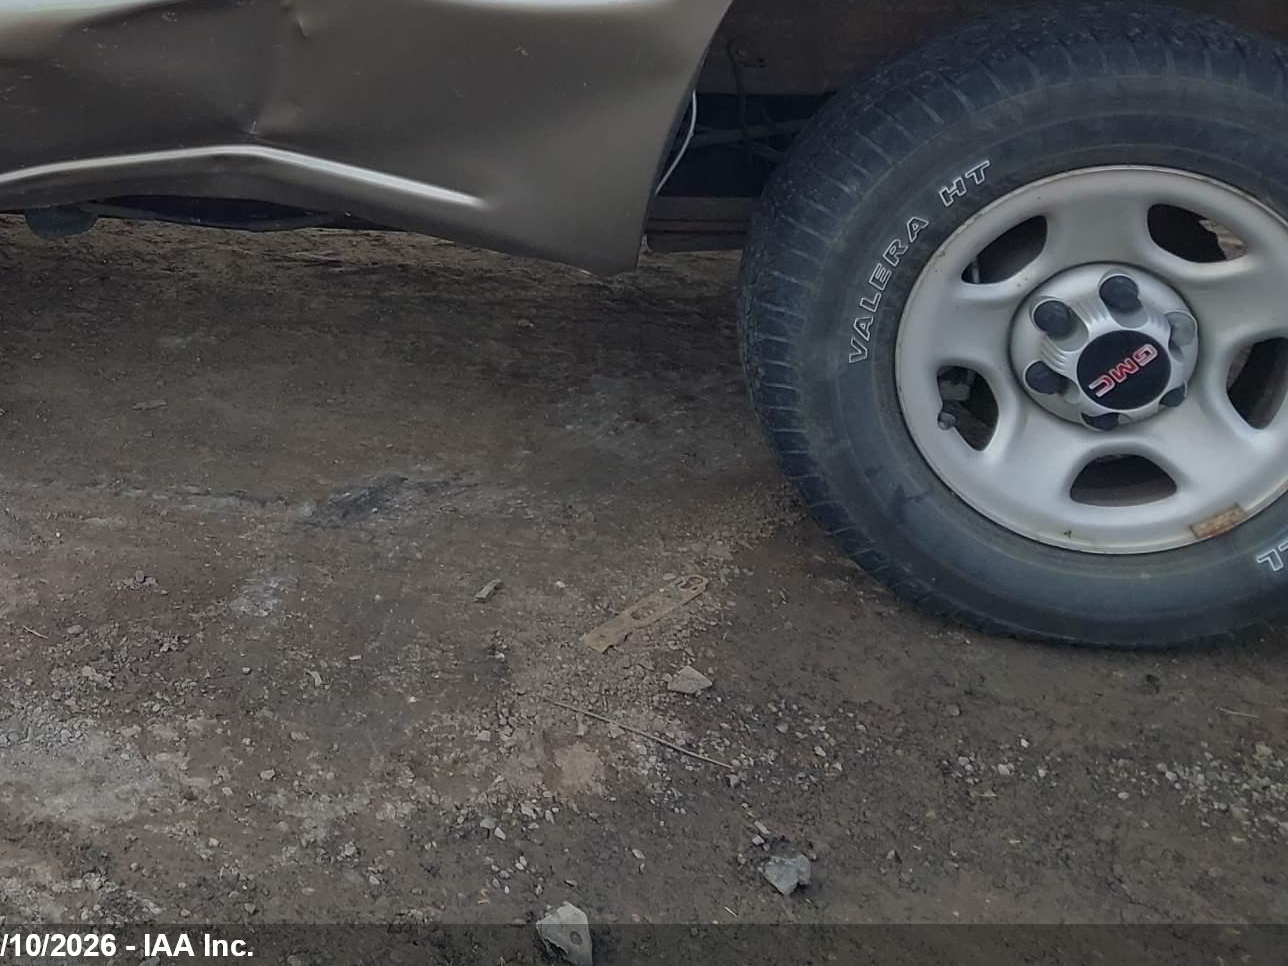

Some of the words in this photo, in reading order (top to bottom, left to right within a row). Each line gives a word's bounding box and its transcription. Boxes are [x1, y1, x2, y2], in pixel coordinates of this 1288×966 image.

[848, 216, 929, 363] VALERA
[939, 160, 990, 207] HT
[1088, 343, 1158, 398] GMC
